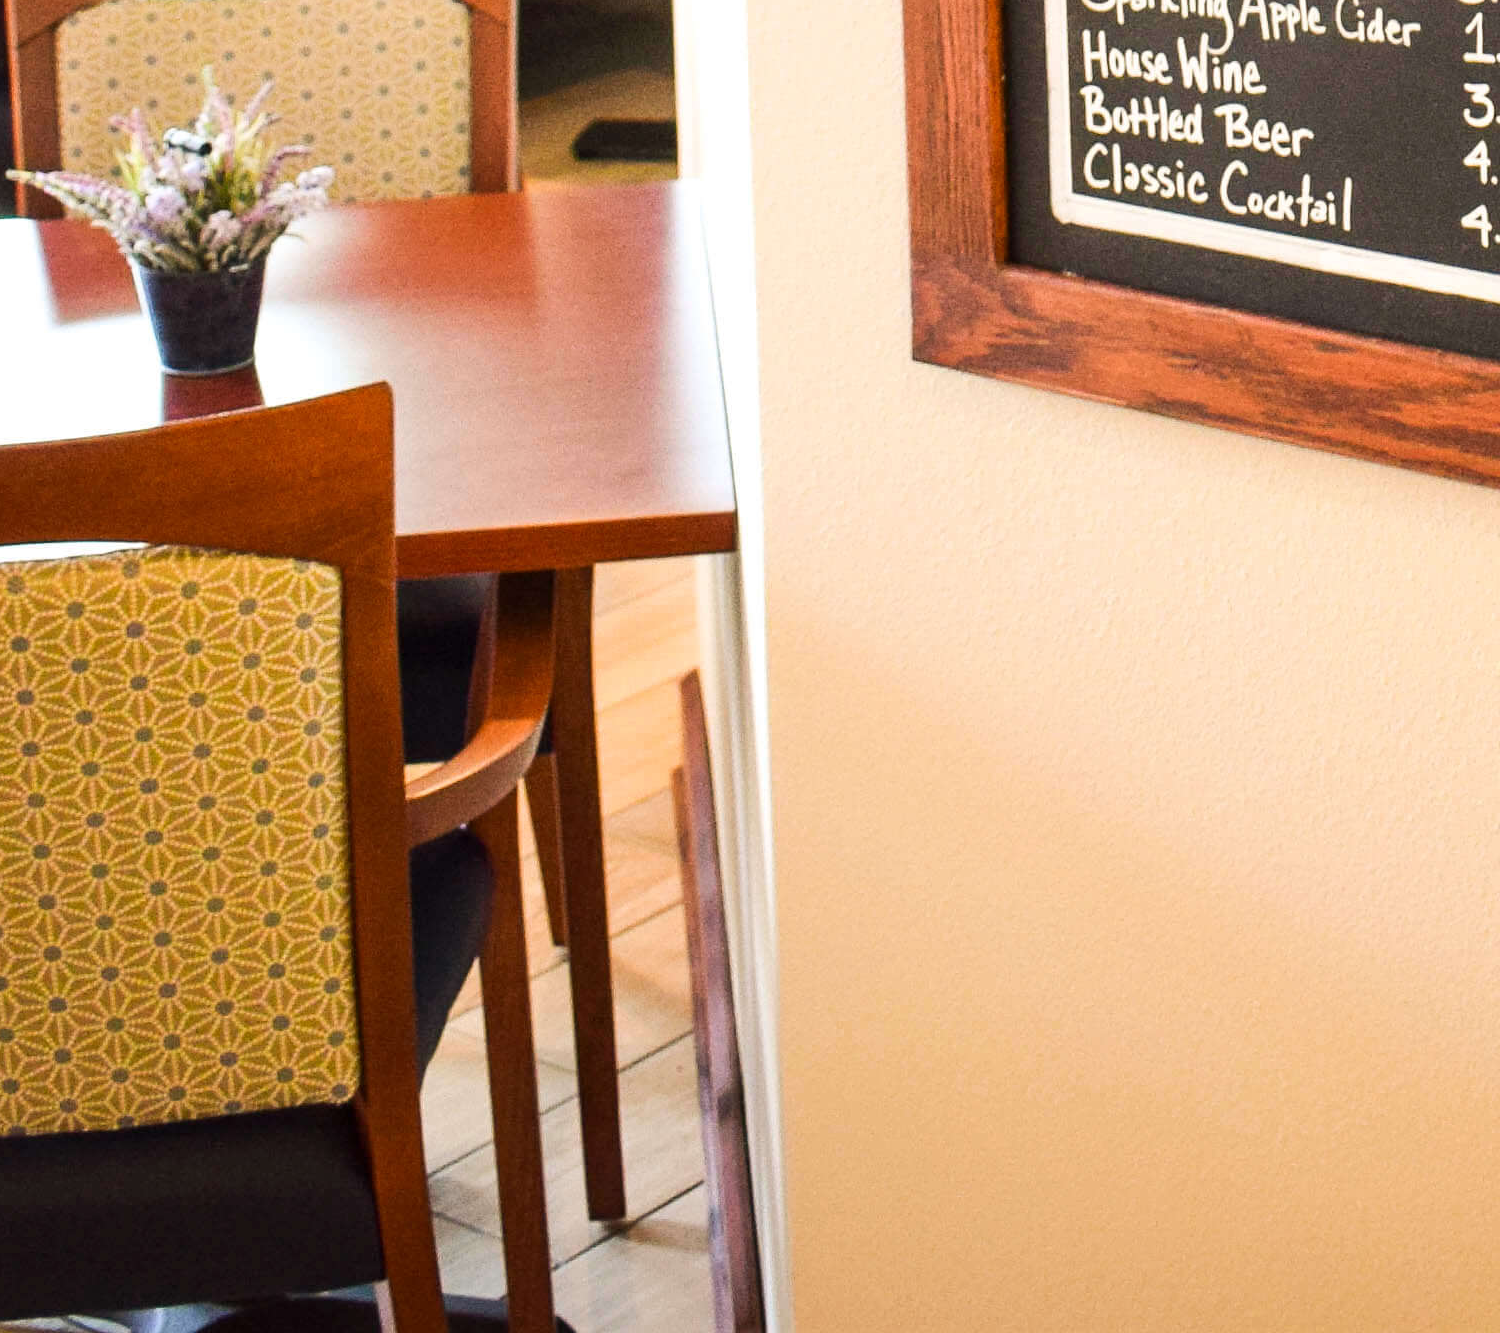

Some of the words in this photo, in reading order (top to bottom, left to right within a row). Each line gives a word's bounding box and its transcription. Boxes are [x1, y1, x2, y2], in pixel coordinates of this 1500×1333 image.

[1082, 29, 1173, 85] House
[1177, 33, 1266, 96] Wine
[1080, 85, 1204, 144] Bottled
[1214, 104, 1314, 157] Beer
[1084, 143, 1208, 203] Classic
[1220, 160, 1352, 231] Cocktail
